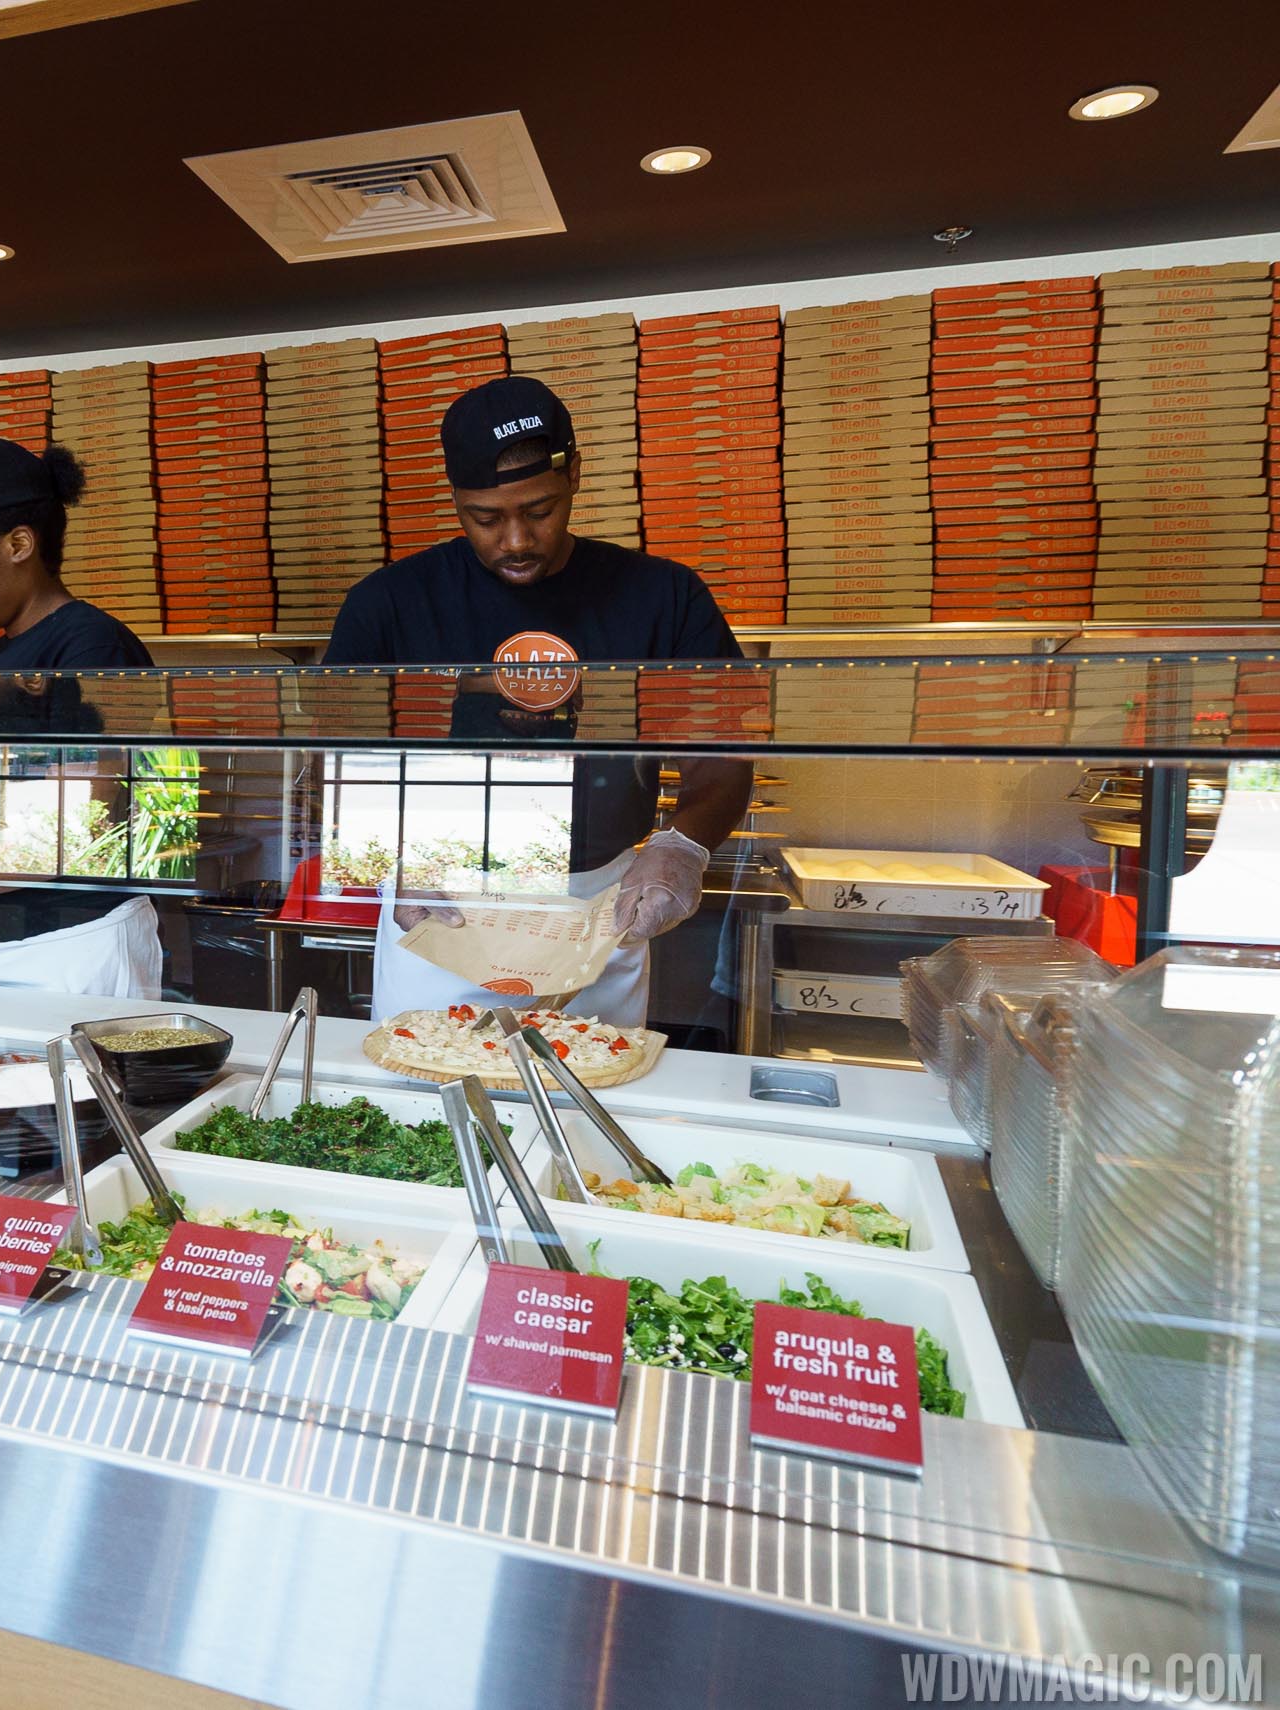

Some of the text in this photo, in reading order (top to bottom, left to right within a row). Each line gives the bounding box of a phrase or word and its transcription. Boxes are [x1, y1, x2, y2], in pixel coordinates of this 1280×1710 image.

[493, 415, 543, 440] BLAZE PIZZA
[504, 650, 568, 680] BLAZE
[509, 682, 564, 692] PIZZA
[5, 1217, 63, 1243] quinoa
[183, 1242, 266, 1268] tomatoes
[160, 1256, 275, 1288] & mozzarella
[163, 1287, 249, 1312] w/ red peppers
[164, 1300, 237, 1323] & basil pesto
[517, 1286, 594, 1314] classic
[514, 1310, 593, 1336] caesar
[484, 1333, 613, 1365] w/ shaved parmesan
[774, 1328, 897, 1365] arugula &
[773, 1348, 900, 1389] fresh fruit
[765, 1382, 907, 1419] w/ goat cheese &
[775, 1398, 897, 1433] balsamic drizzle
